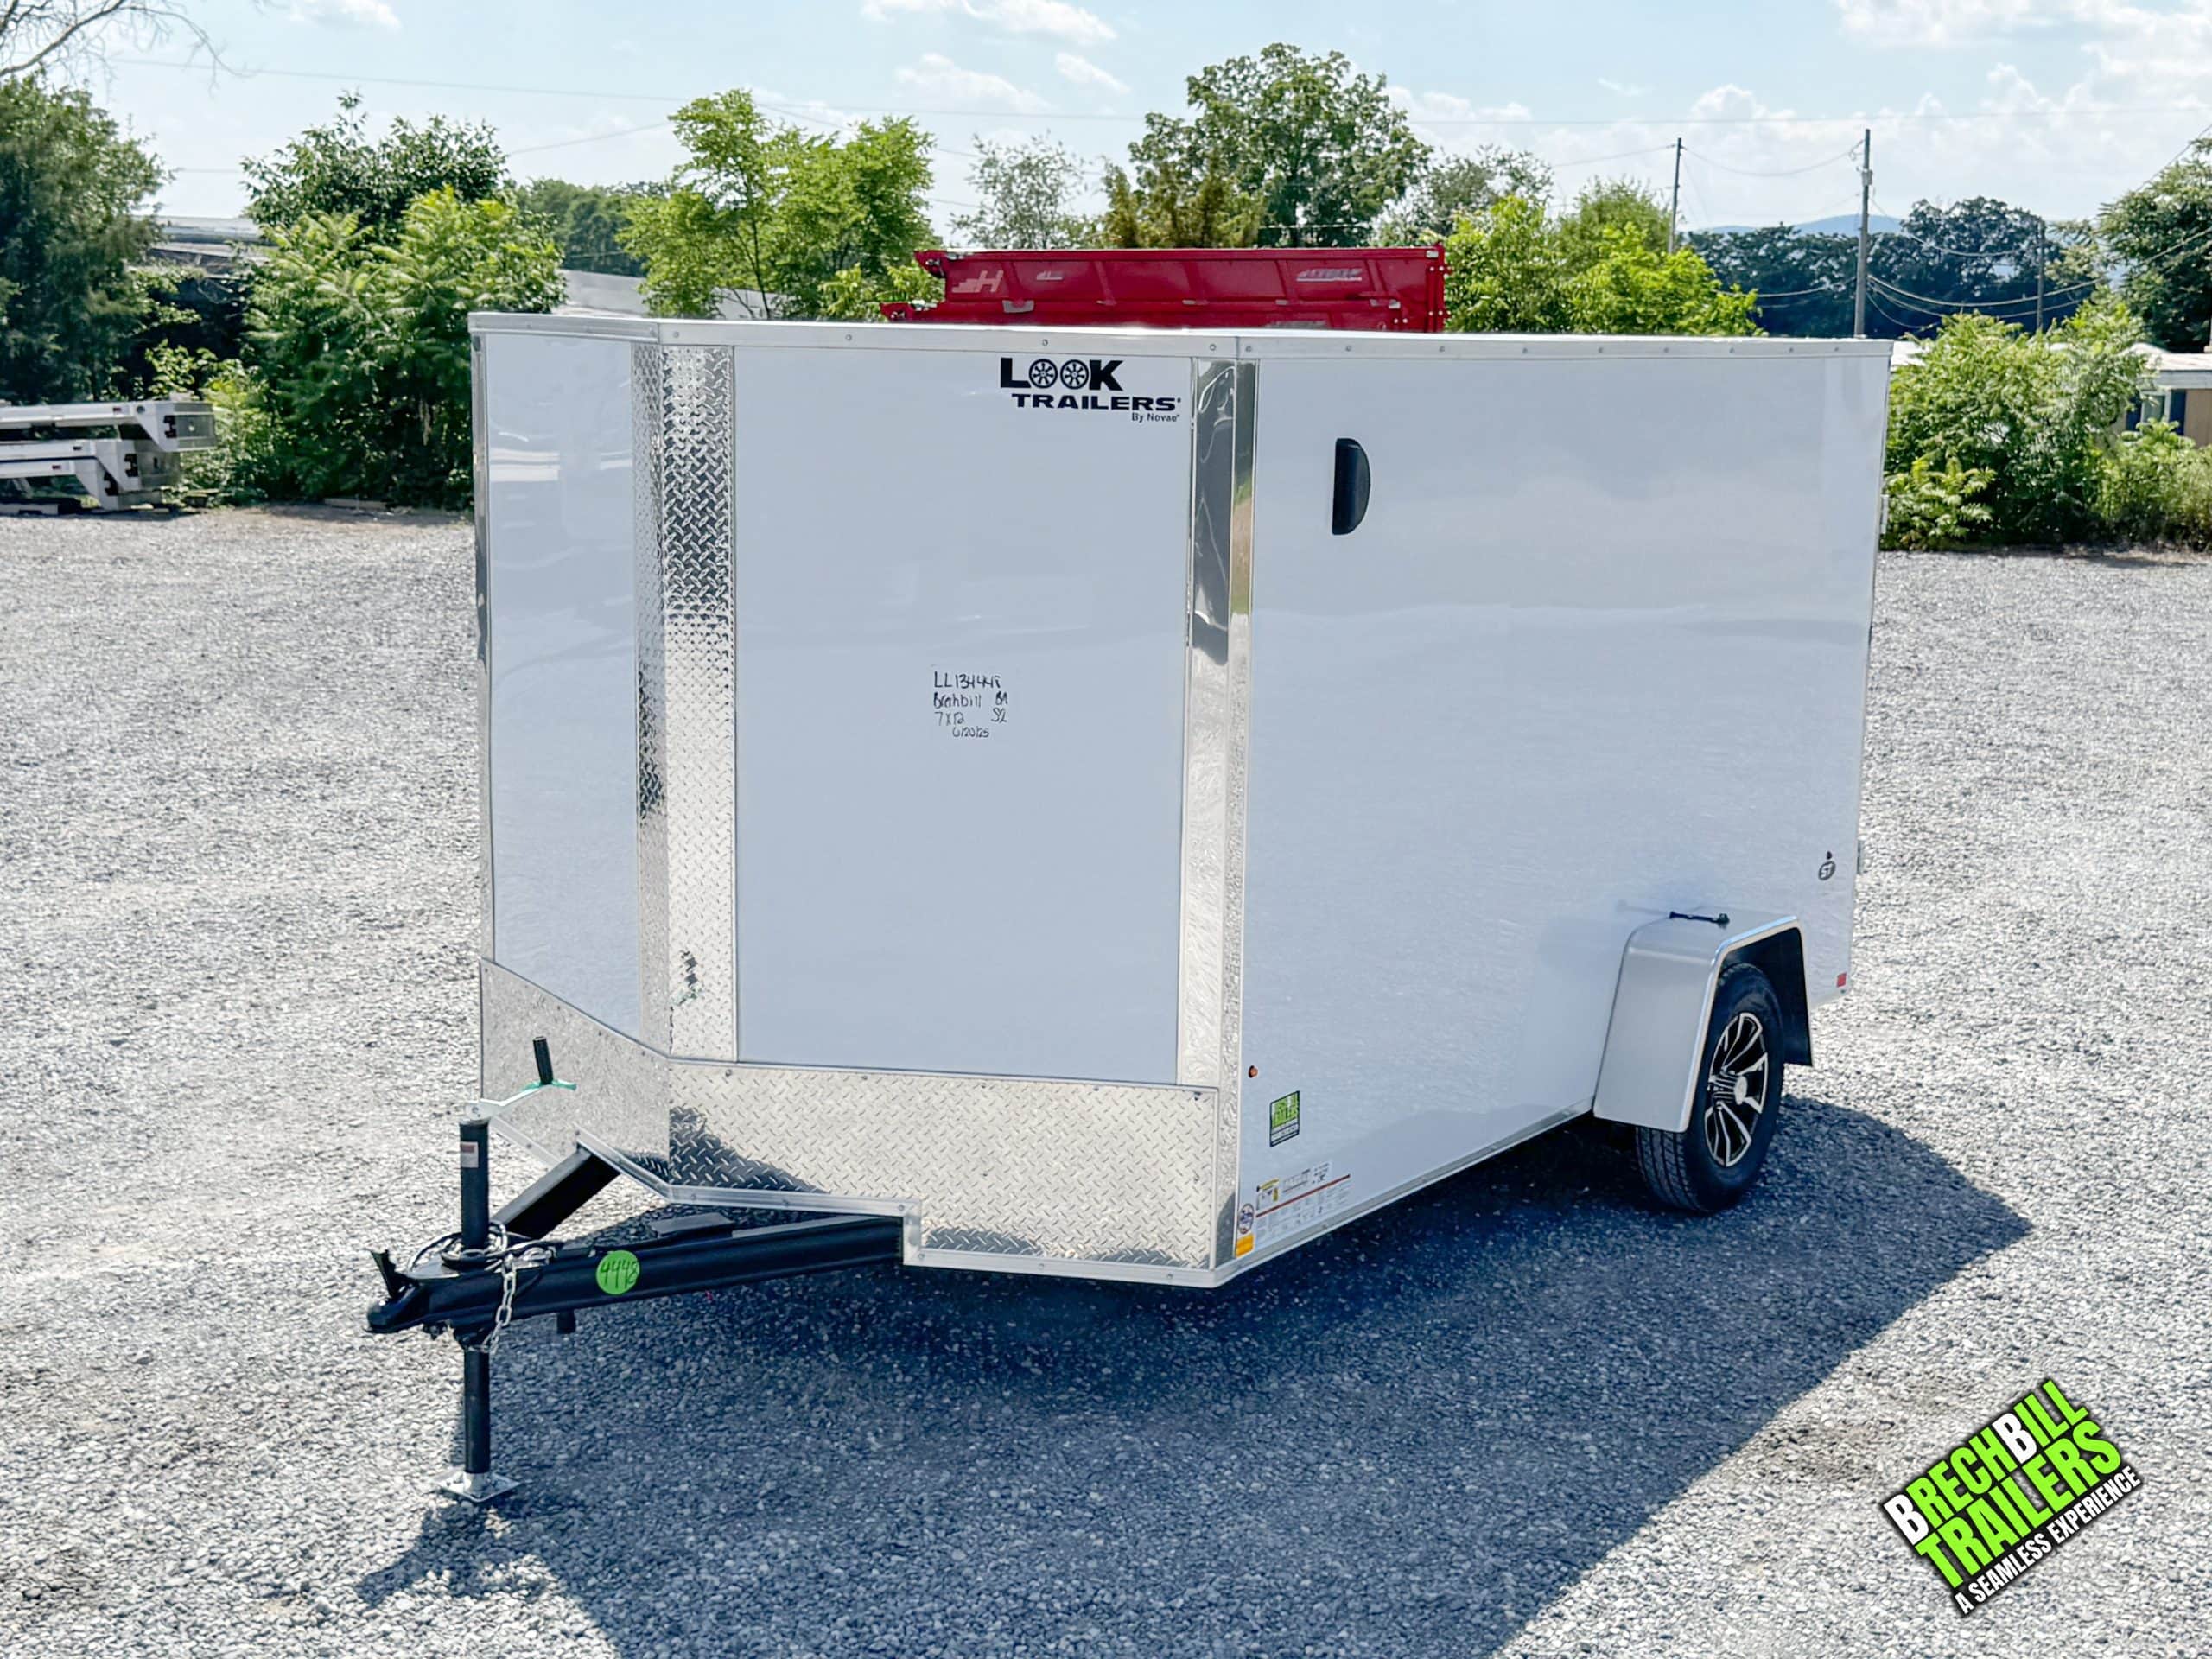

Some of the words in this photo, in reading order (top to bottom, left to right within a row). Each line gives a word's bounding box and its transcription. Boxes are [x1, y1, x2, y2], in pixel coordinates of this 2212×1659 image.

[1000, 357, 1124, 391] LOOK
[1011, 393, 1181, 411] TRAILERS
[1131, 412, 1144, 423] By
